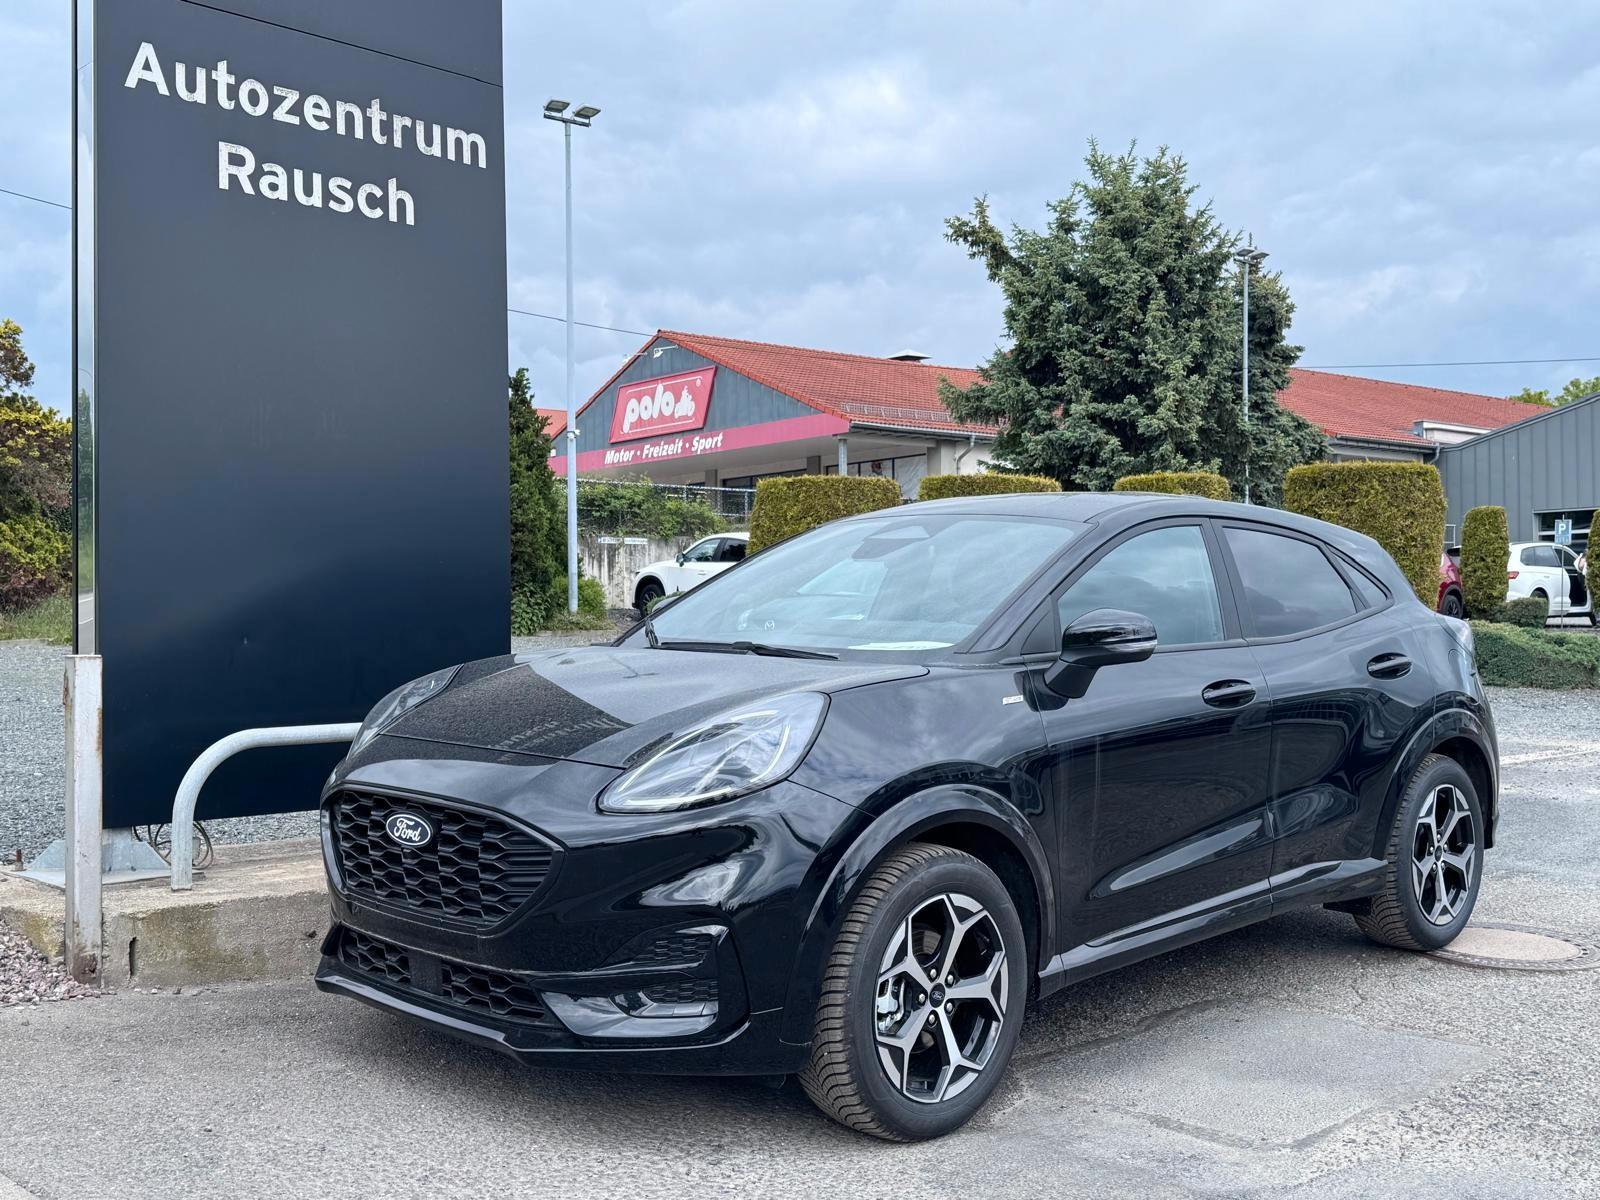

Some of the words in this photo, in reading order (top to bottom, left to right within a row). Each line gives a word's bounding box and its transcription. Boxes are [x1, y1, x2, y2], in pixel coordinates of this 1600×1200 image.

[125, 41, 486, 168] Autozentrum
[218, 141, 415, 225] Rausch
[623, 384, 675, 433] polo
[604, 450, 634, 464] Motor
[642, 439, 683, 459] Freizeit
[691, 432, 723, 454] Sport
[1558, 523, 1566, 535] P
[393, 817, 422, 841] Ford
